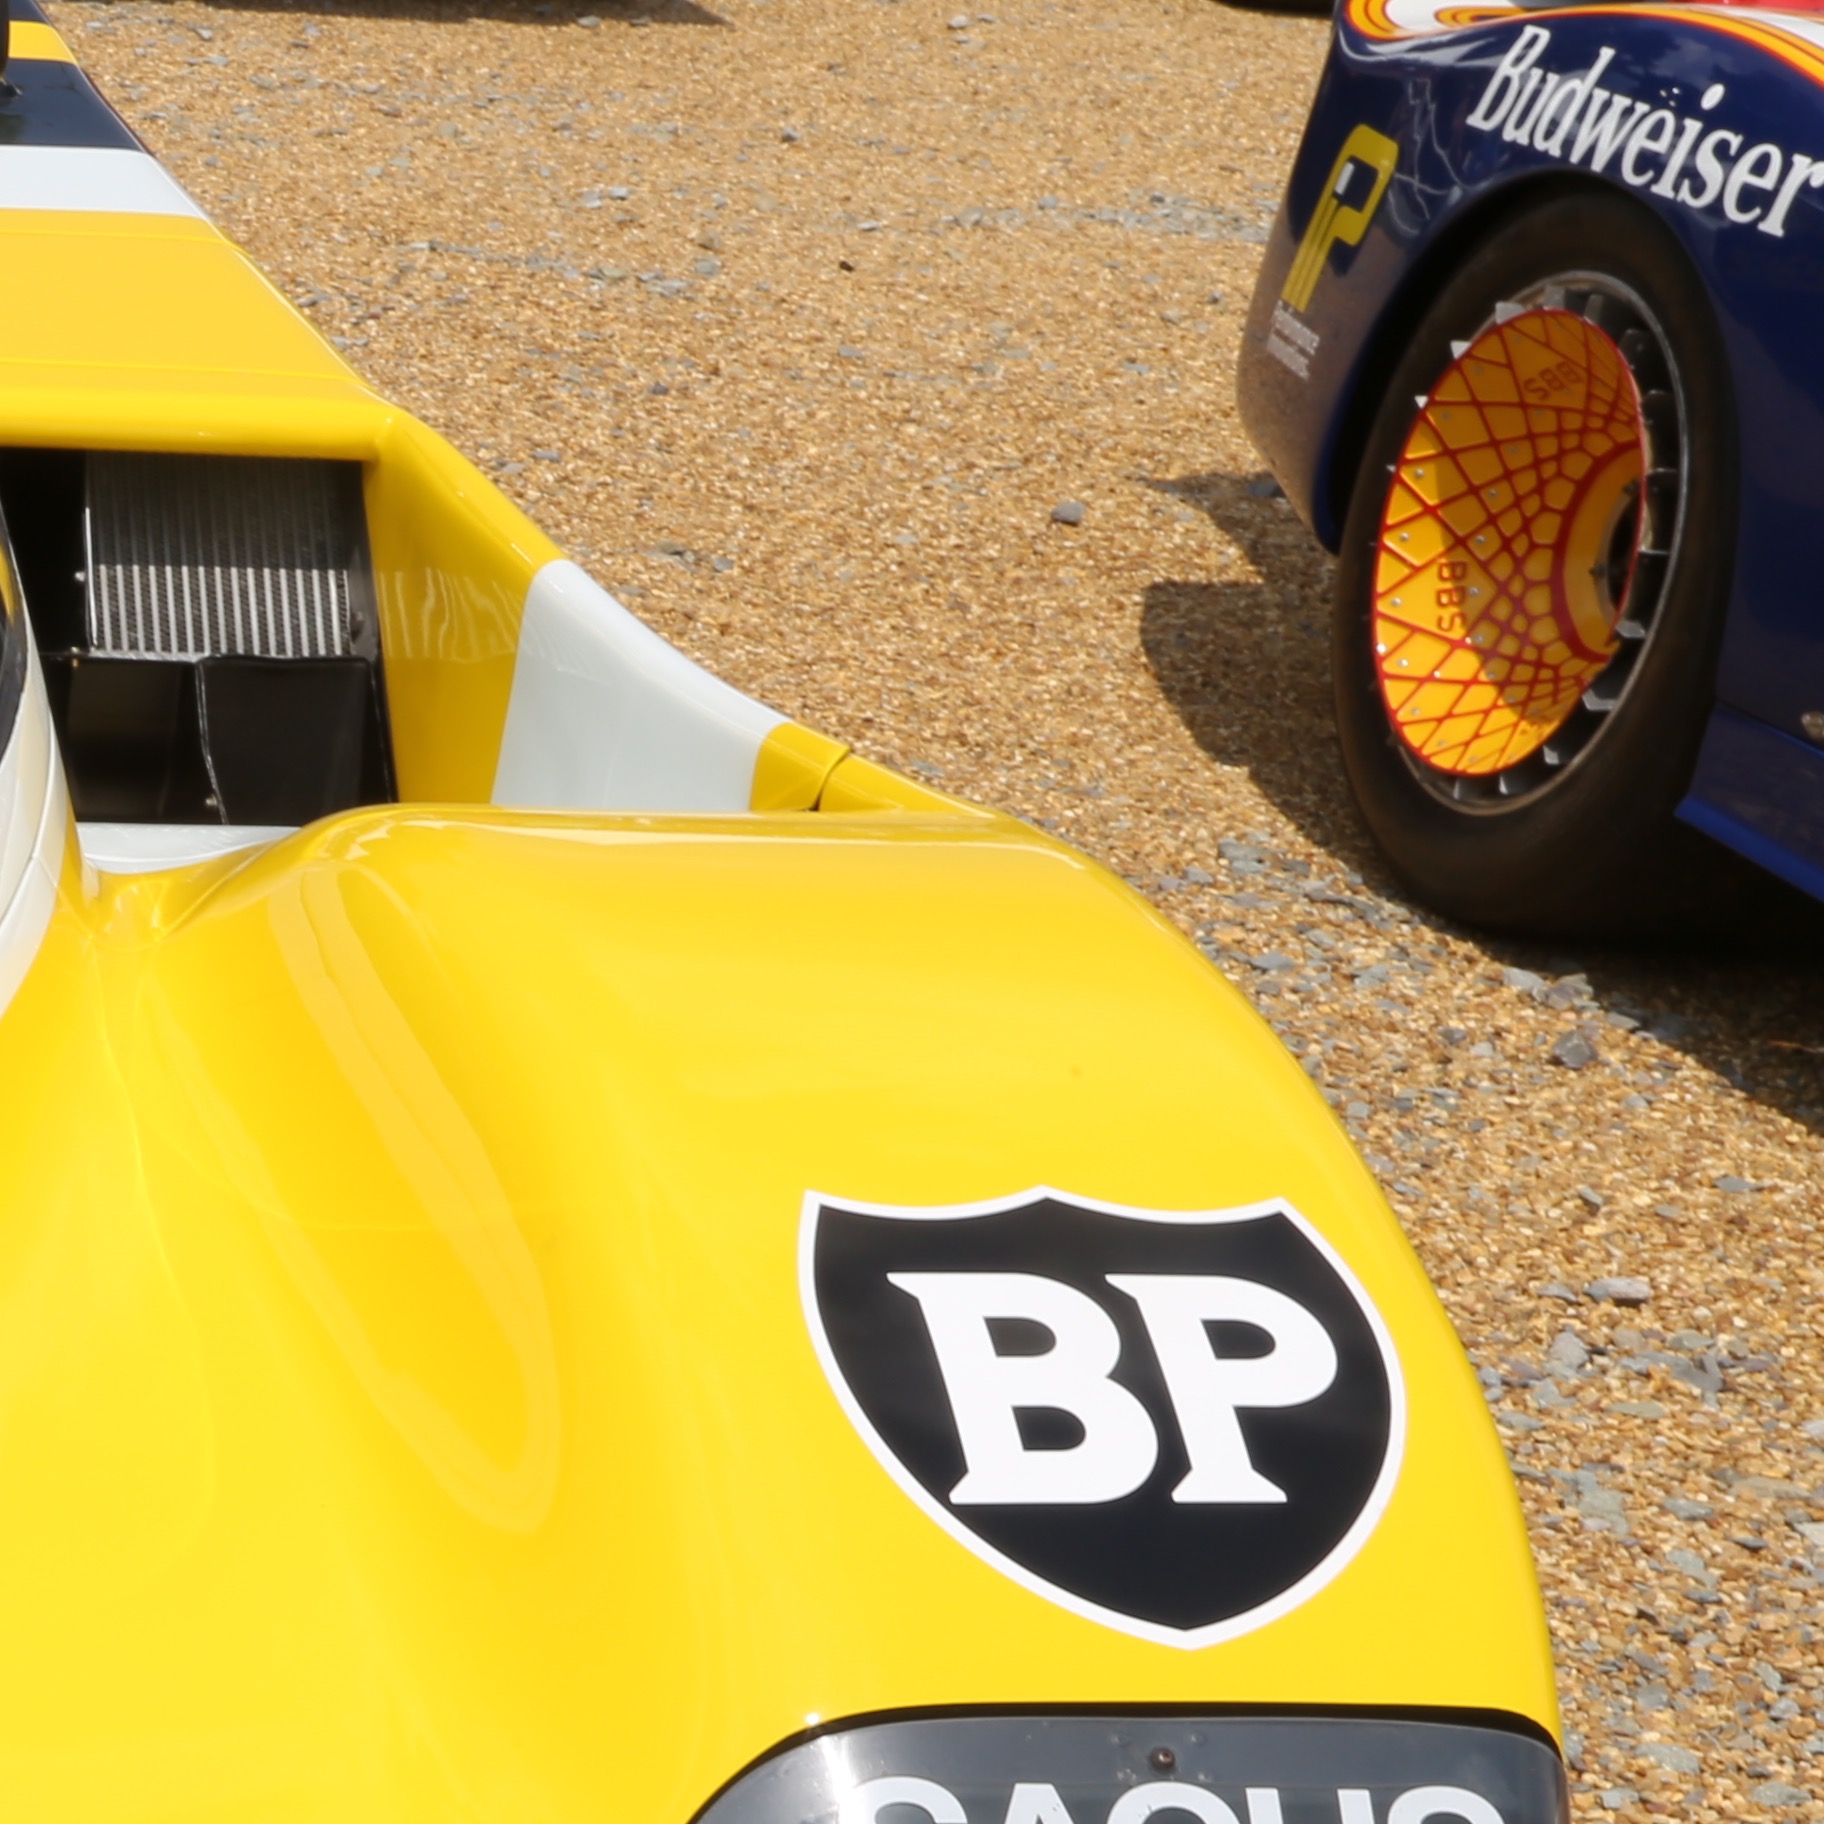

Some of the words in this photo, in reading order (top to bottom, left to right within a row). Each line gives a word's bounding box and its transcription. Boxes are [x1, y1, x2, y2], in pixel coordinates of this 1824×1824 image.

[1466, 24, 1824, 237] Budweiser
[1437, 560, 1469, 634] BBS
[886, 1271, 1339, 1505] BP
